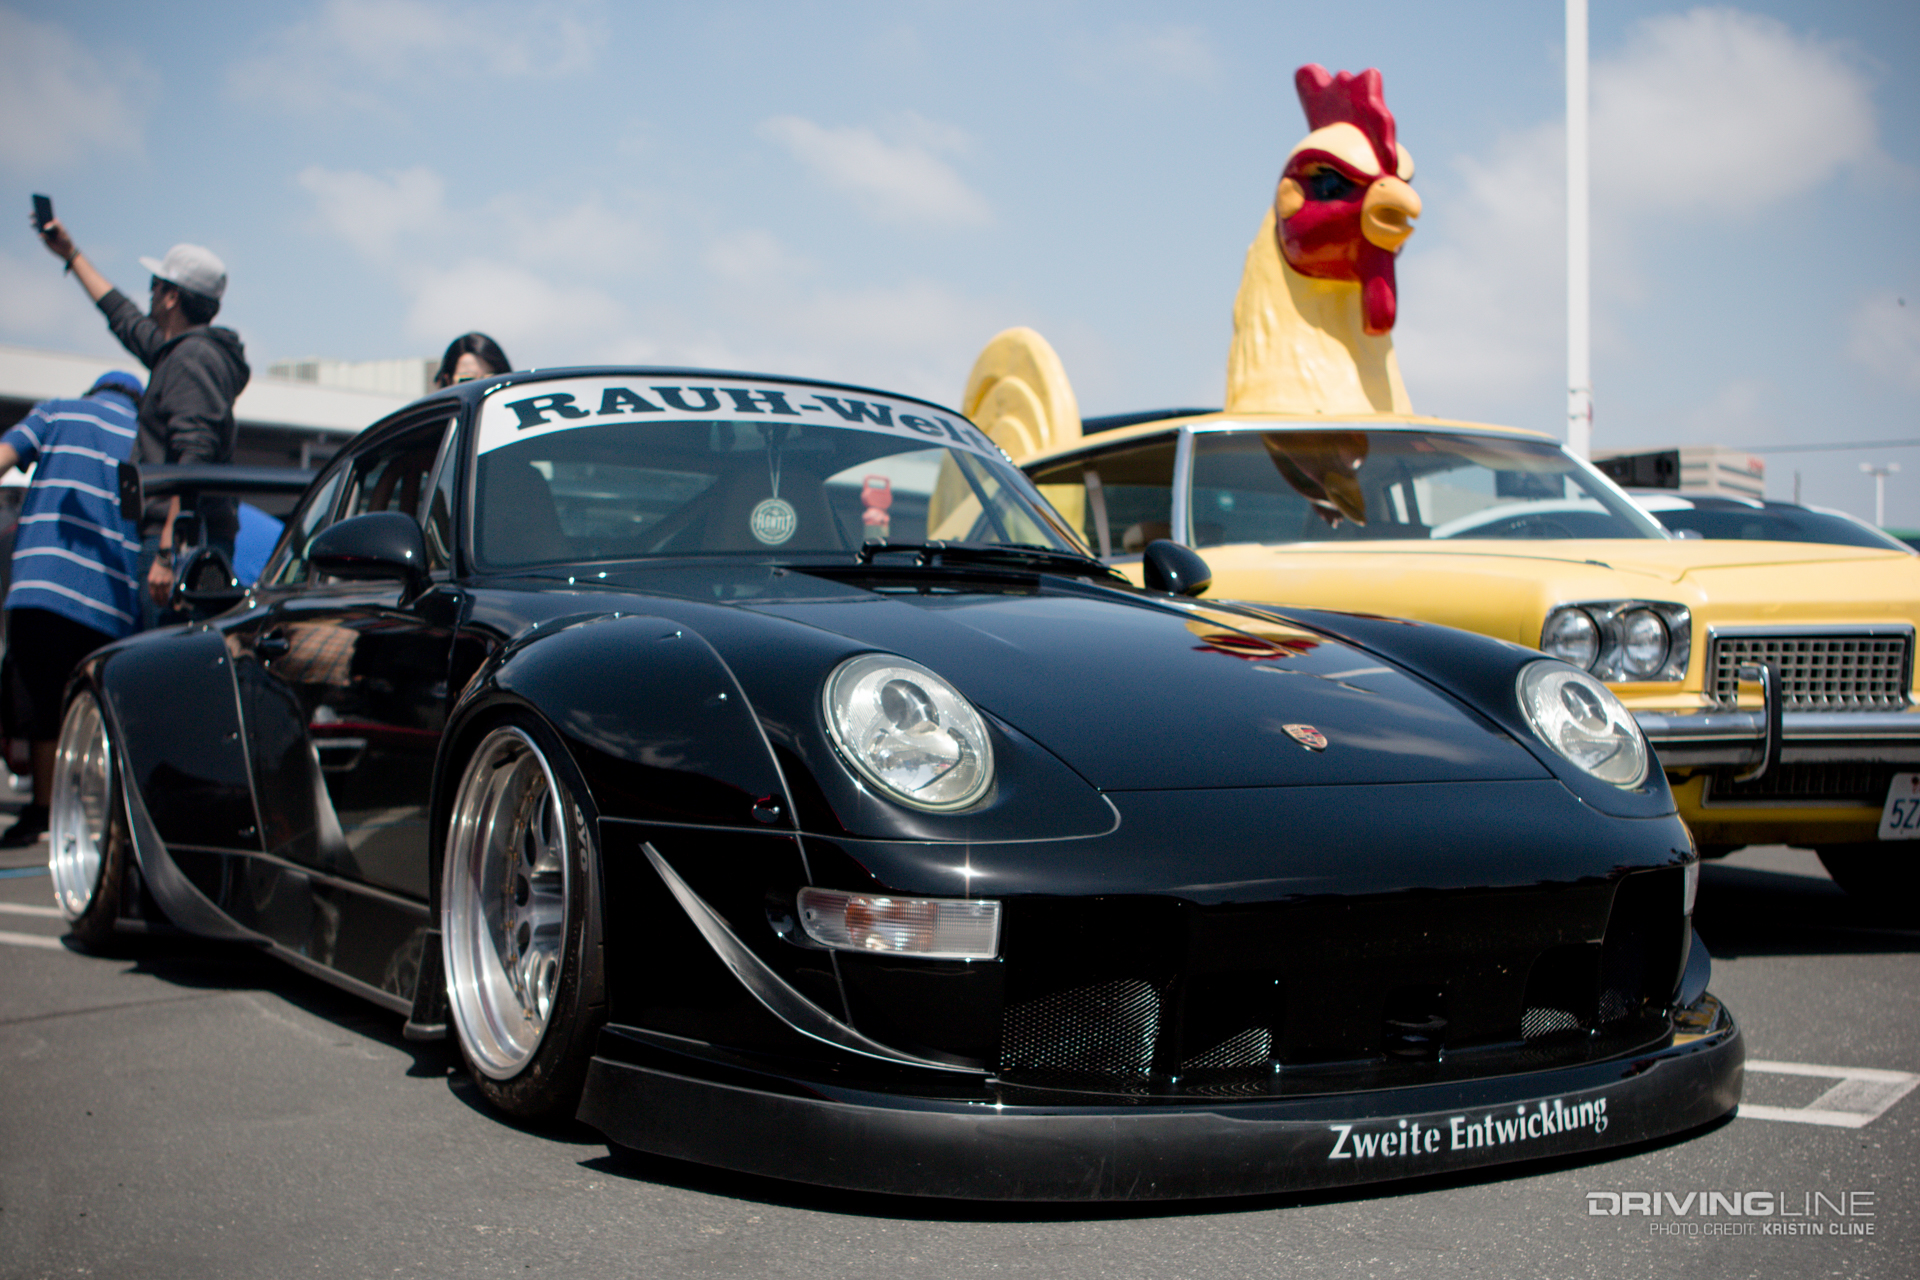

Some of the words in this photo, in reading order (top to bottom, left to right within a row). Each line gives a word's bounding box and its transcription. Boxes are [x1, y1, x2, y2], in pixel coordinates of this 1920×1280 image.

[504, 386, 994, 457] RAUH-Welt
[574, 804, 588, 872] OYO
[1889, 798, 1920, 829] 5Z
[1328, 1118, 1441, 1160] Zweite
[1450, 1097, 1608, 1151] Entwicklung
